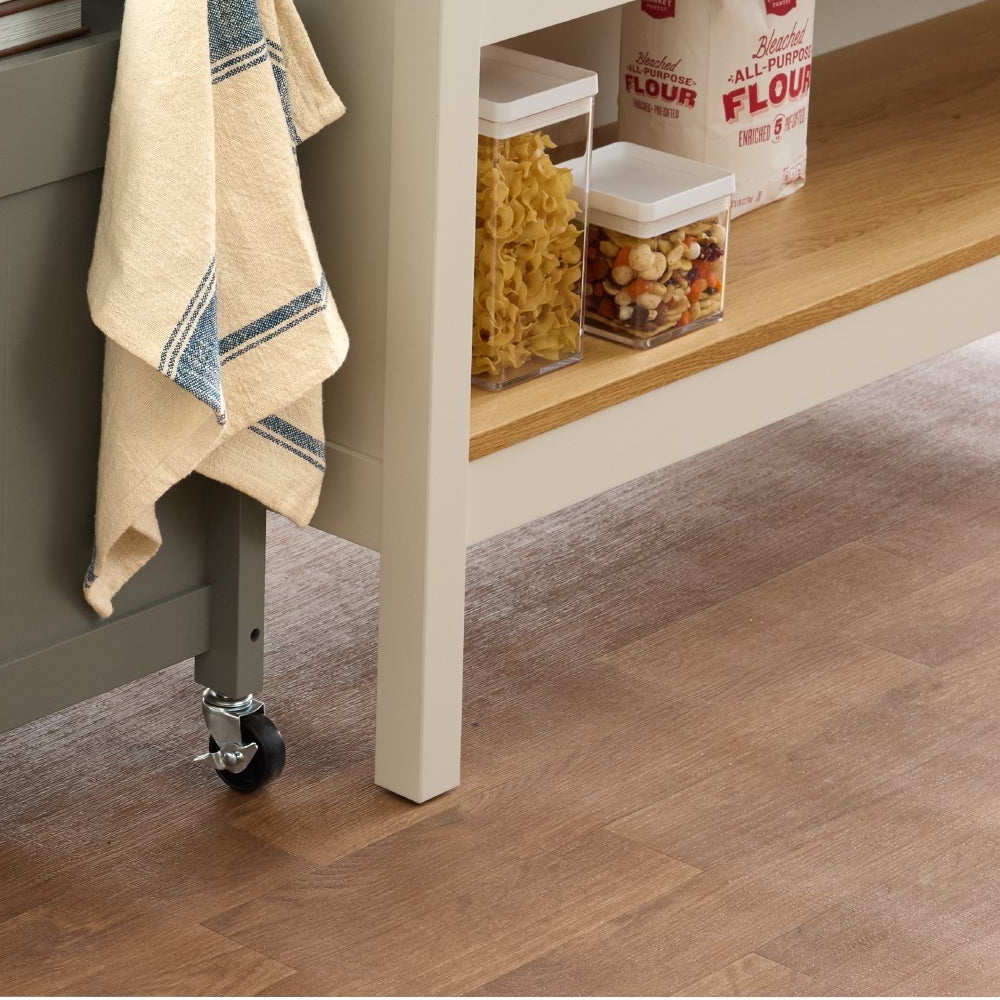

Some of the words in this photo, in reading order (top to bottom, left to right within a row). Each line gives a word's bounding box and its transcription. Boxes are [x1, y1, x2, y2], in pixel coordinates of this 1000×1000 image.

[752, 17, 810, 59] Bleached
[627, 63, 694, 87] ALL-PURPOSE
[635, 51, 682, 72] Bleached
[625, 74, 698, 110] FLOUR
[738, 124, 771, 147] ENRICHED
[774, 117, 783, 136] 5
